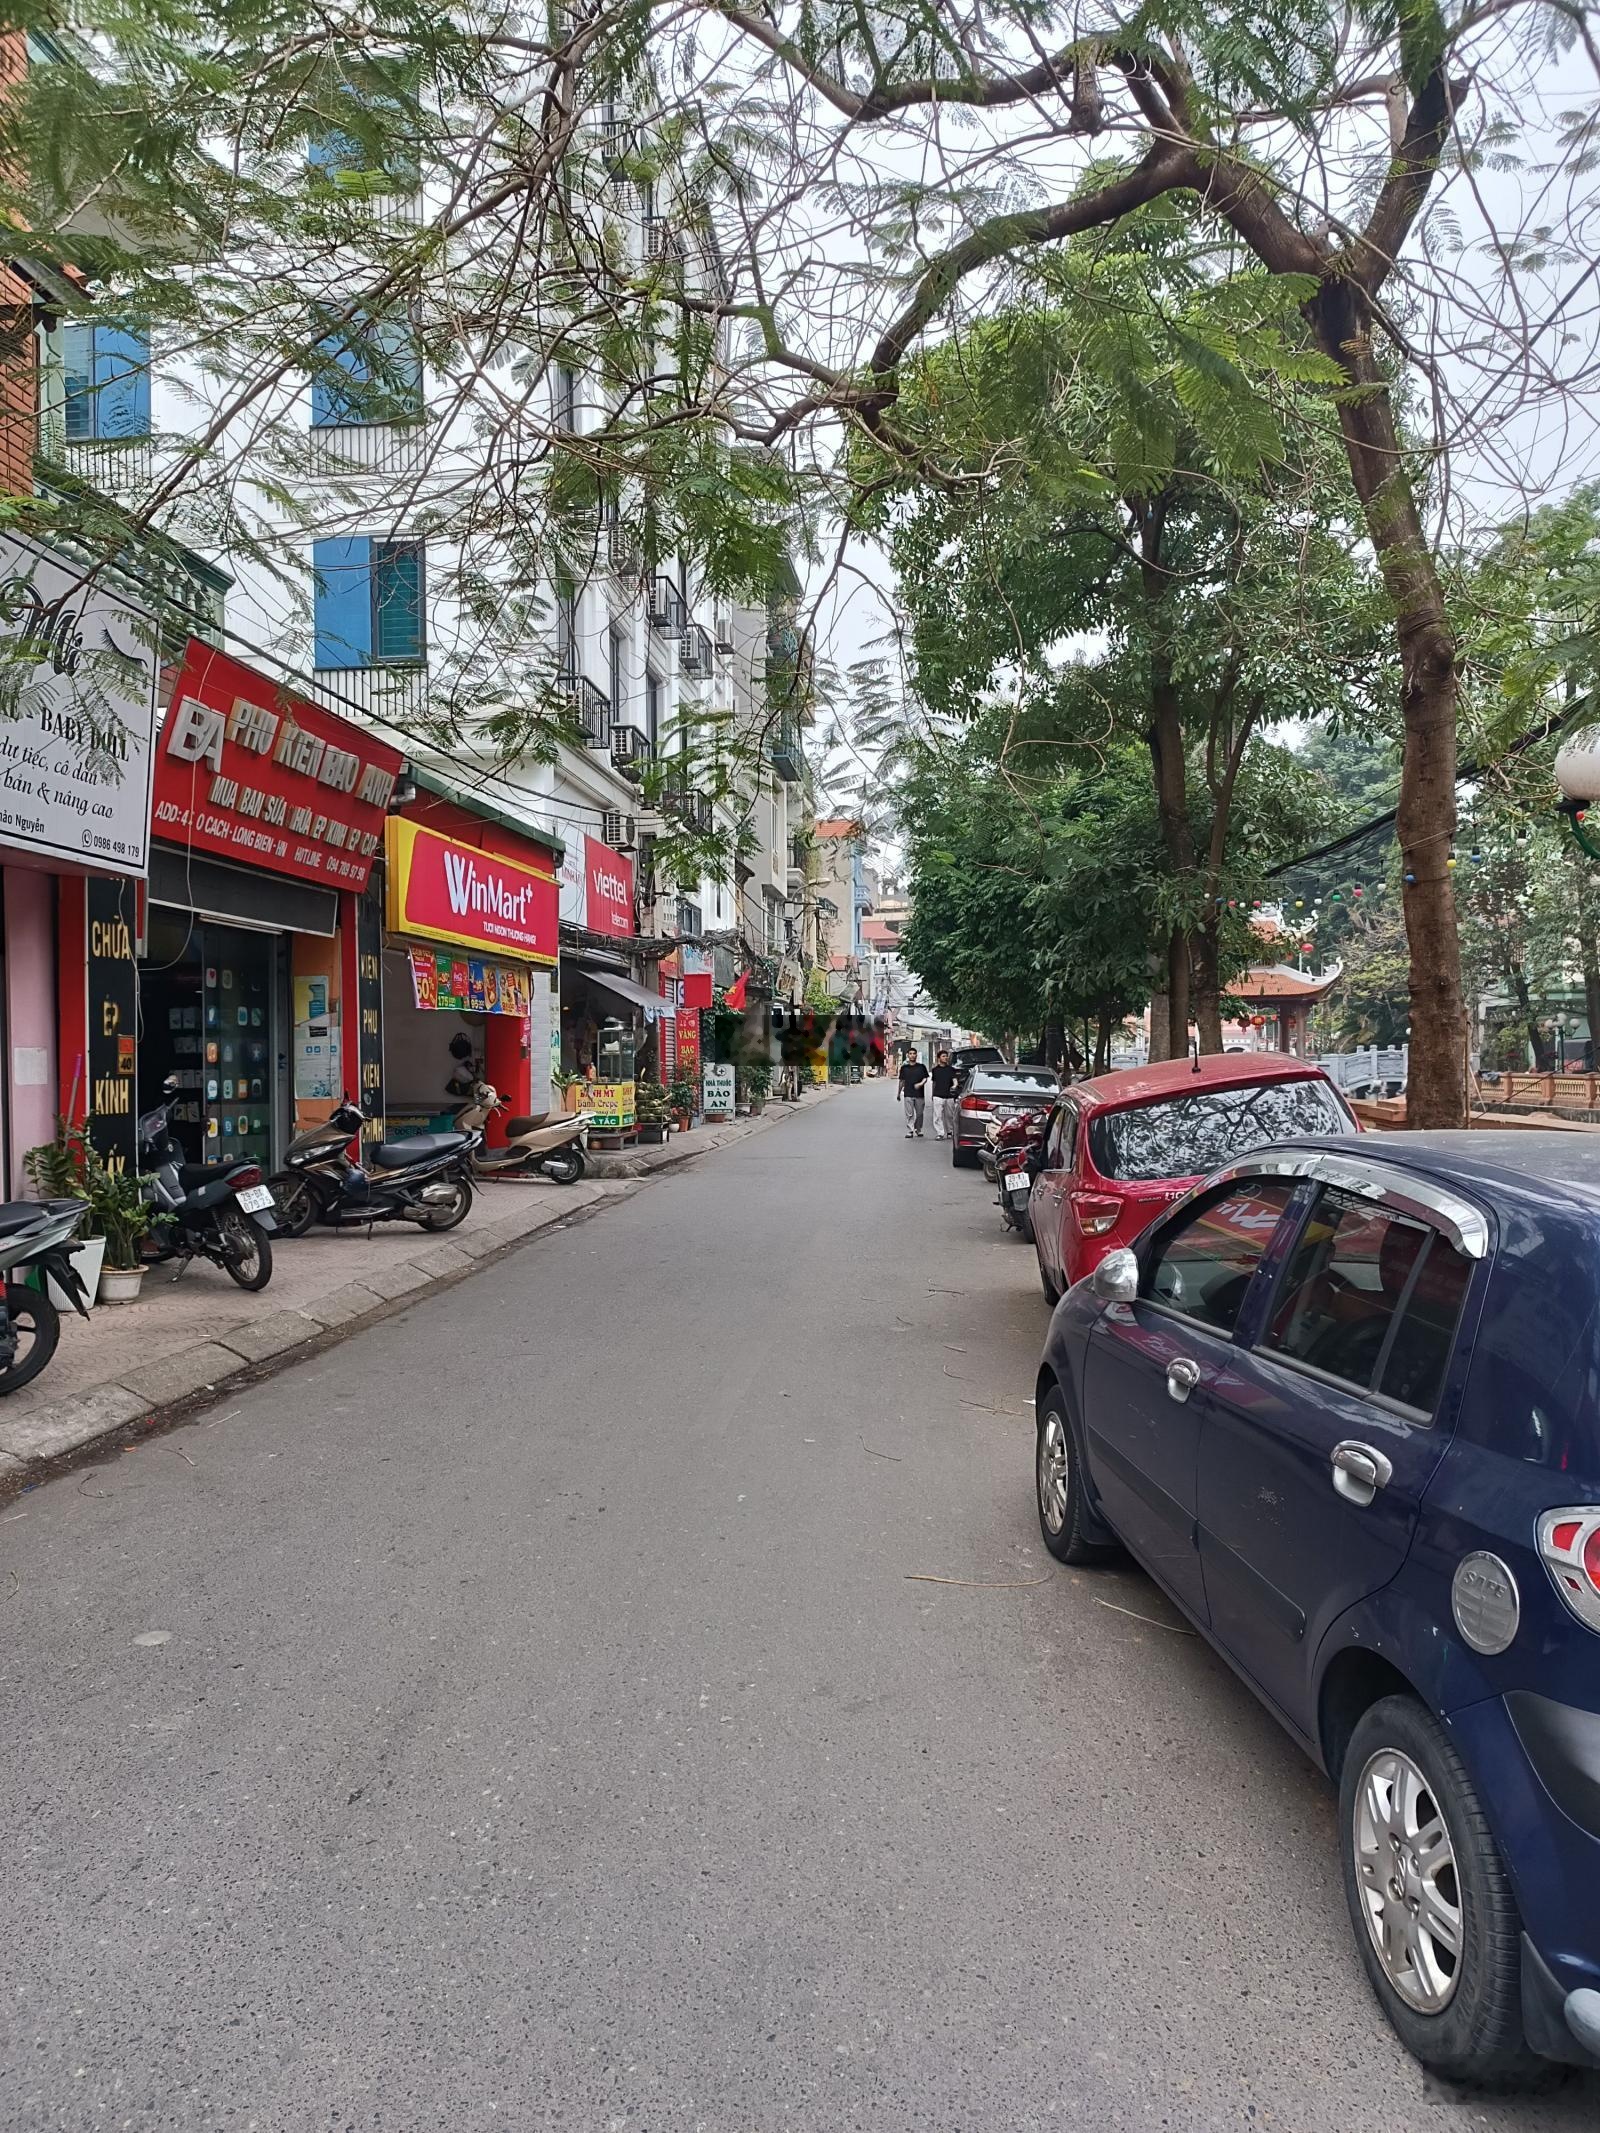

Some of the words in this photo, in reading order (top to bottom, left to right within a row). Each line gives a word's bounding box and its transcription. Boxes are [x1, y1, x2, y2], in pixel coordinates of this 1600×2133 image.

[40, 706, 83, 745] BABY
[166, 694, 226, 774] BA
[54, 760, 70, 776] cô
[37, 781, 51, 805] &
[53, 790, 90, 817] nâng
[91, 801, 114, 819] cao
[208, 775, 239, 810] MUA
[93, 834, 111, 850] 0986
[112, 840, 126, 855] 498
[128, 844, 140, 858] 179
[592, 866, 628, 906] viettel
[92, 915, 131, 961] CHỮA
[120, 1057, 132, 1071] 40
[95, 1071, 130, 1116] KÍNH
[710, 1100, 727, 1108] AN
